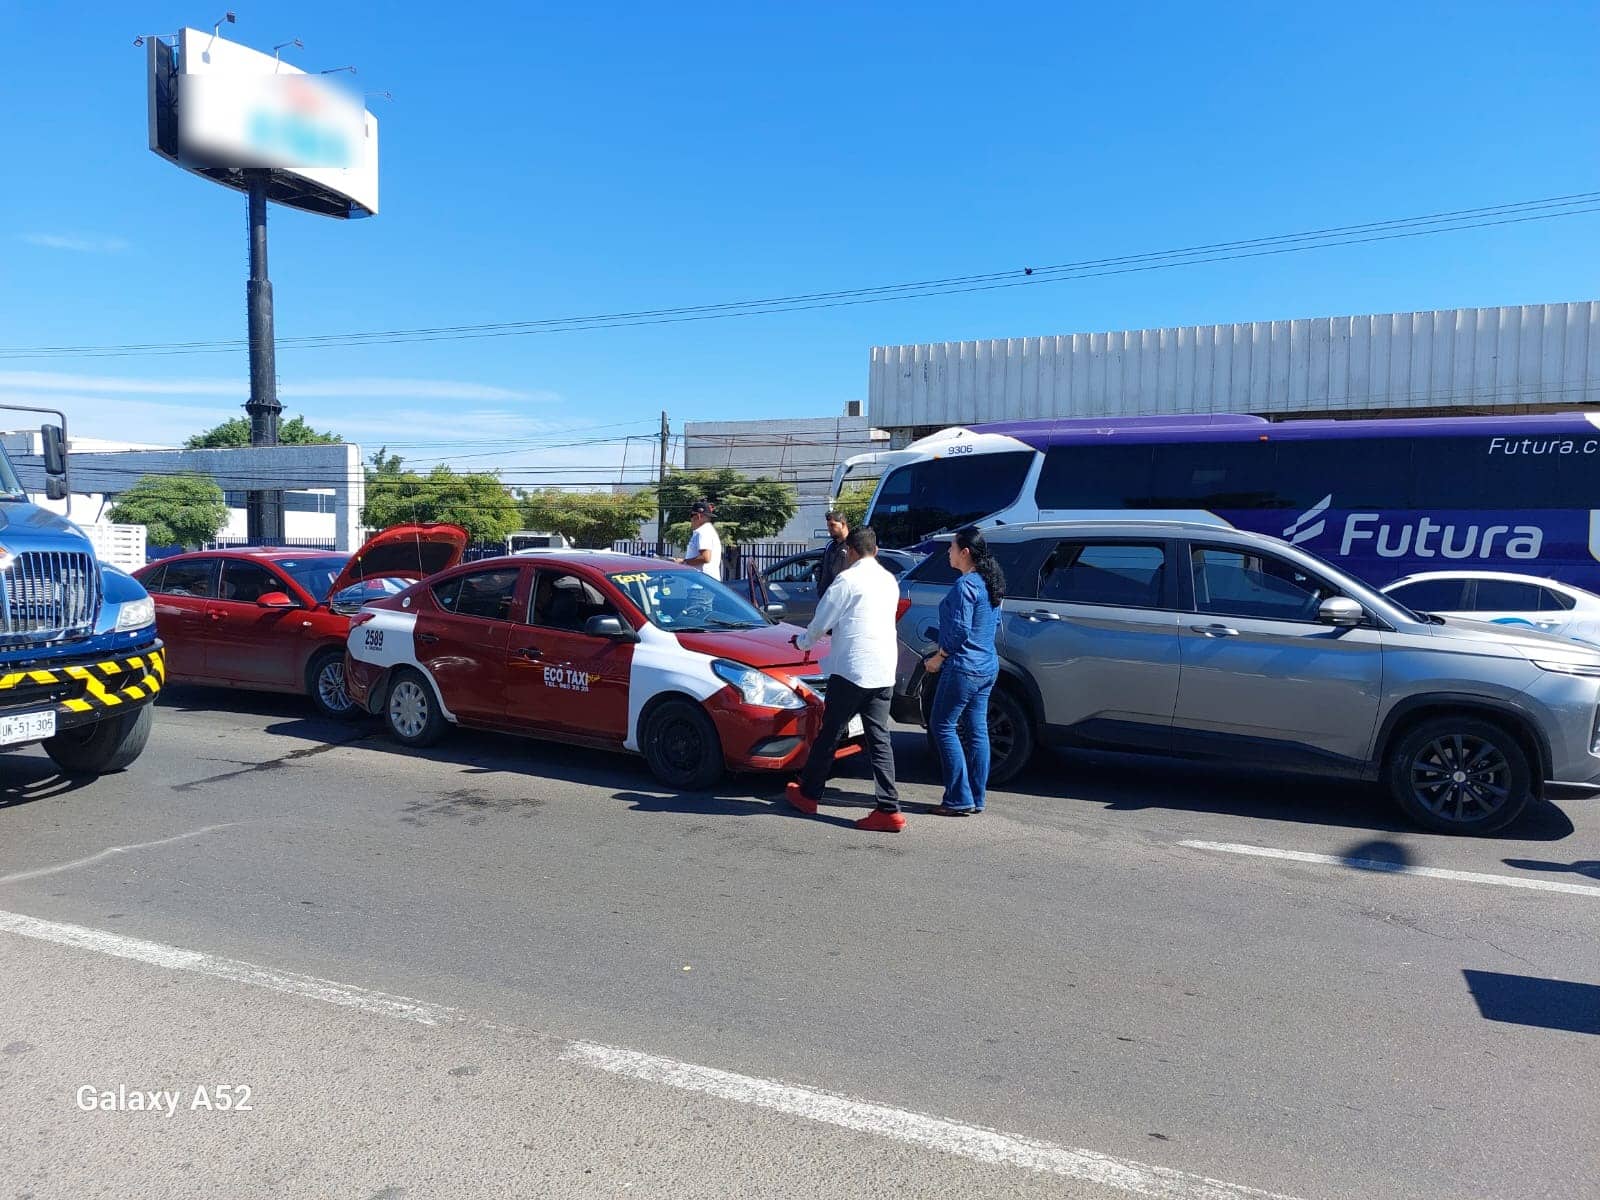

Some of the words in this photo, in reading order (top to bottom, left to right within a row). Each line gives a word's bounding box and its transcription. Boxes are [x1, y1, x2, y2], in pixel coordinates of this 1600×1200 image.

[948, 444, 973, 455] 9306
[1488, 438, 1598, 455] Futura.c
[1340, 513, 1543, 559] Futura
[365, 630, 383, 646] 2589
[544, 666, 563, 682] ECO
[566, 669, 588, 686] TAXI
